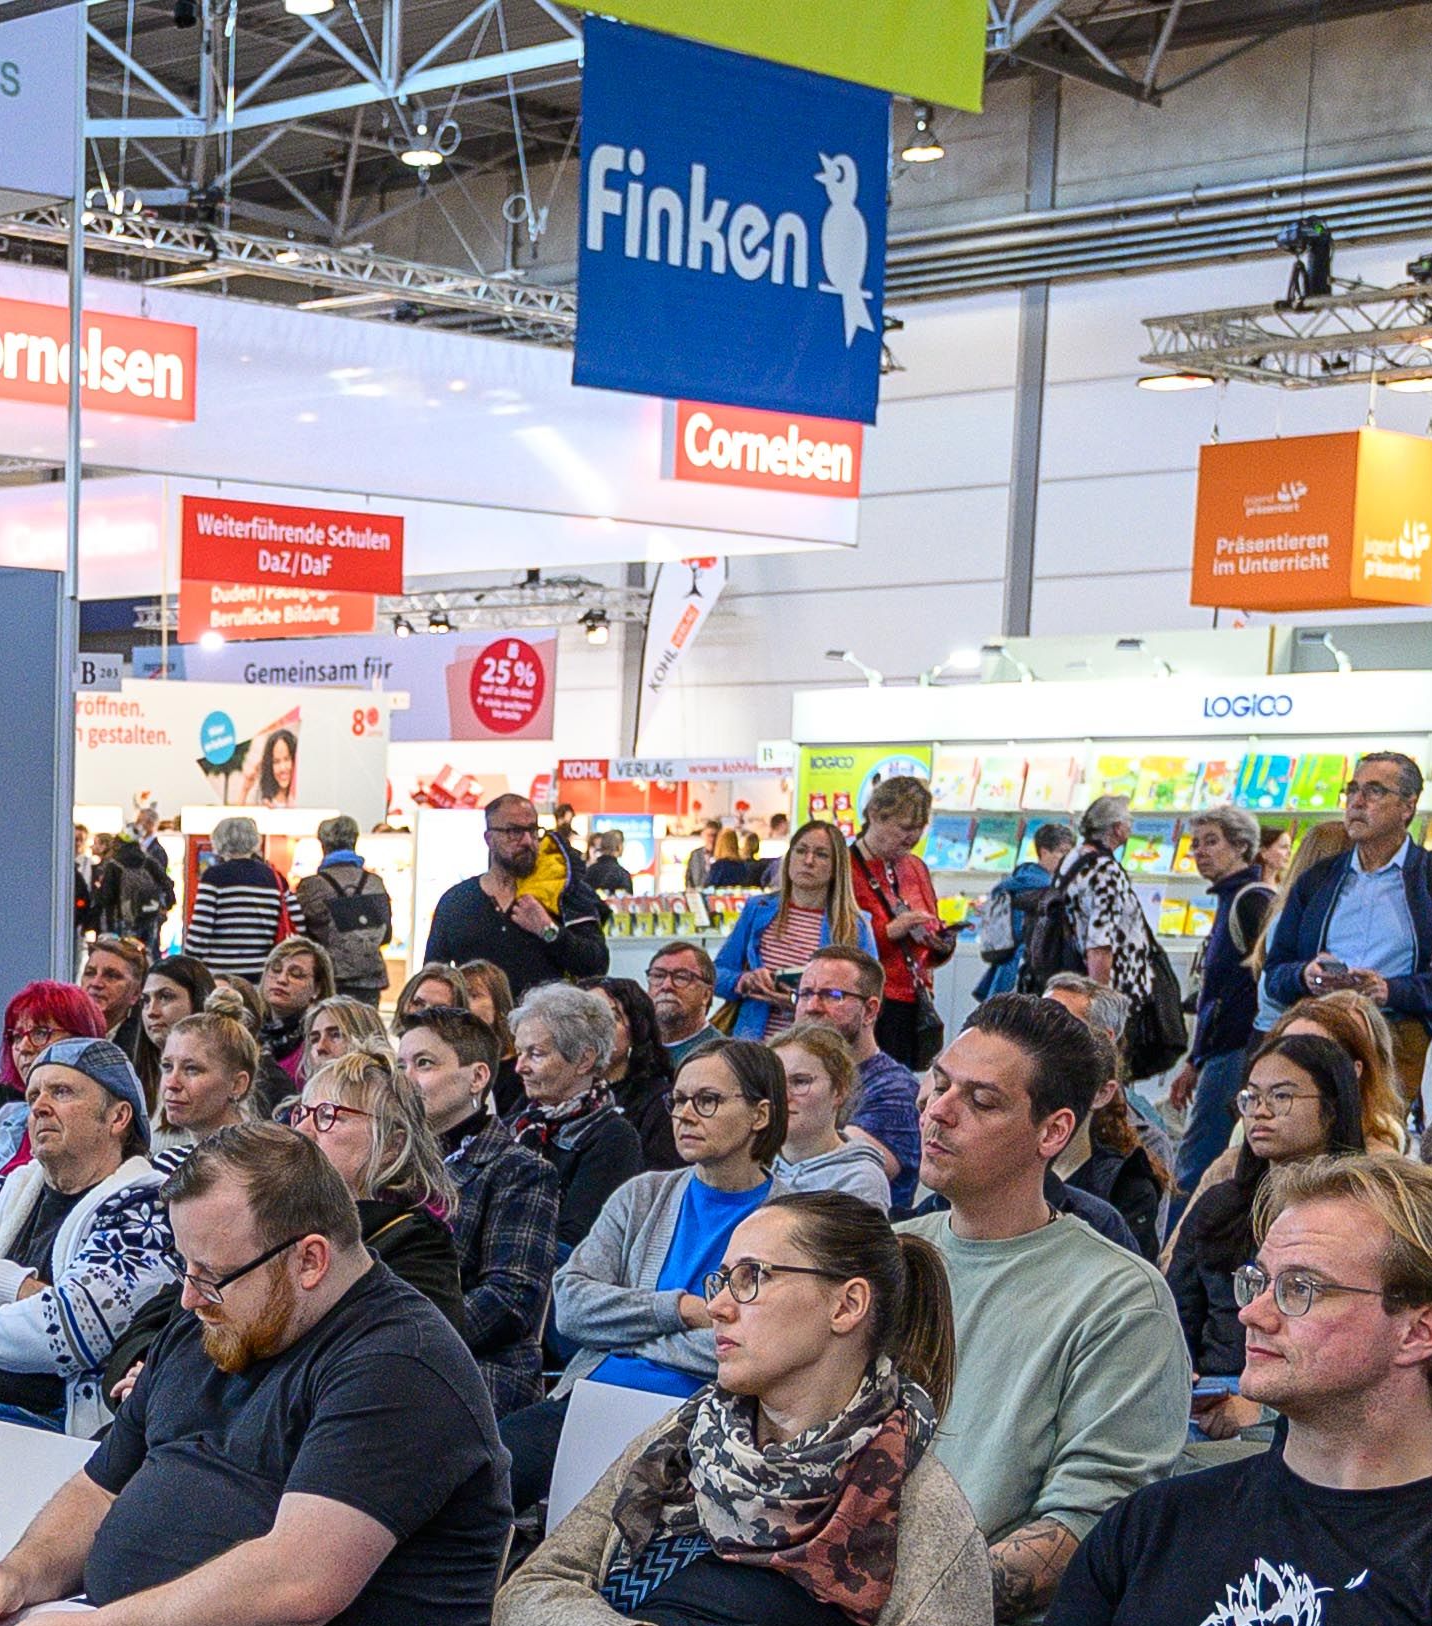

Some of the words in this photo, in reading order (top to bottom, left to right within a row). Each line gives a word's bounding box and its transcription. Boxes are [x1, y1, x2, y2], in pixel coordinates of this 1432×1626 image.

[587, 144, 809, 289] Finken
[683, 411, 853, 484] Cornelsen
[197, 512, 325, 546] Weiterführende
[328, 525, 391, 550] Schulen
[1216, 533, 1329, 555] Präsentieren
[1213, 558, 1234, 576] im
[1238, 551, 1330, 575] Unterricht
[244, 660, 357, 685] Gemeinsam
[563, 762, 602, 779] KOHL
[615, 761, 673, 778] VERLAG
